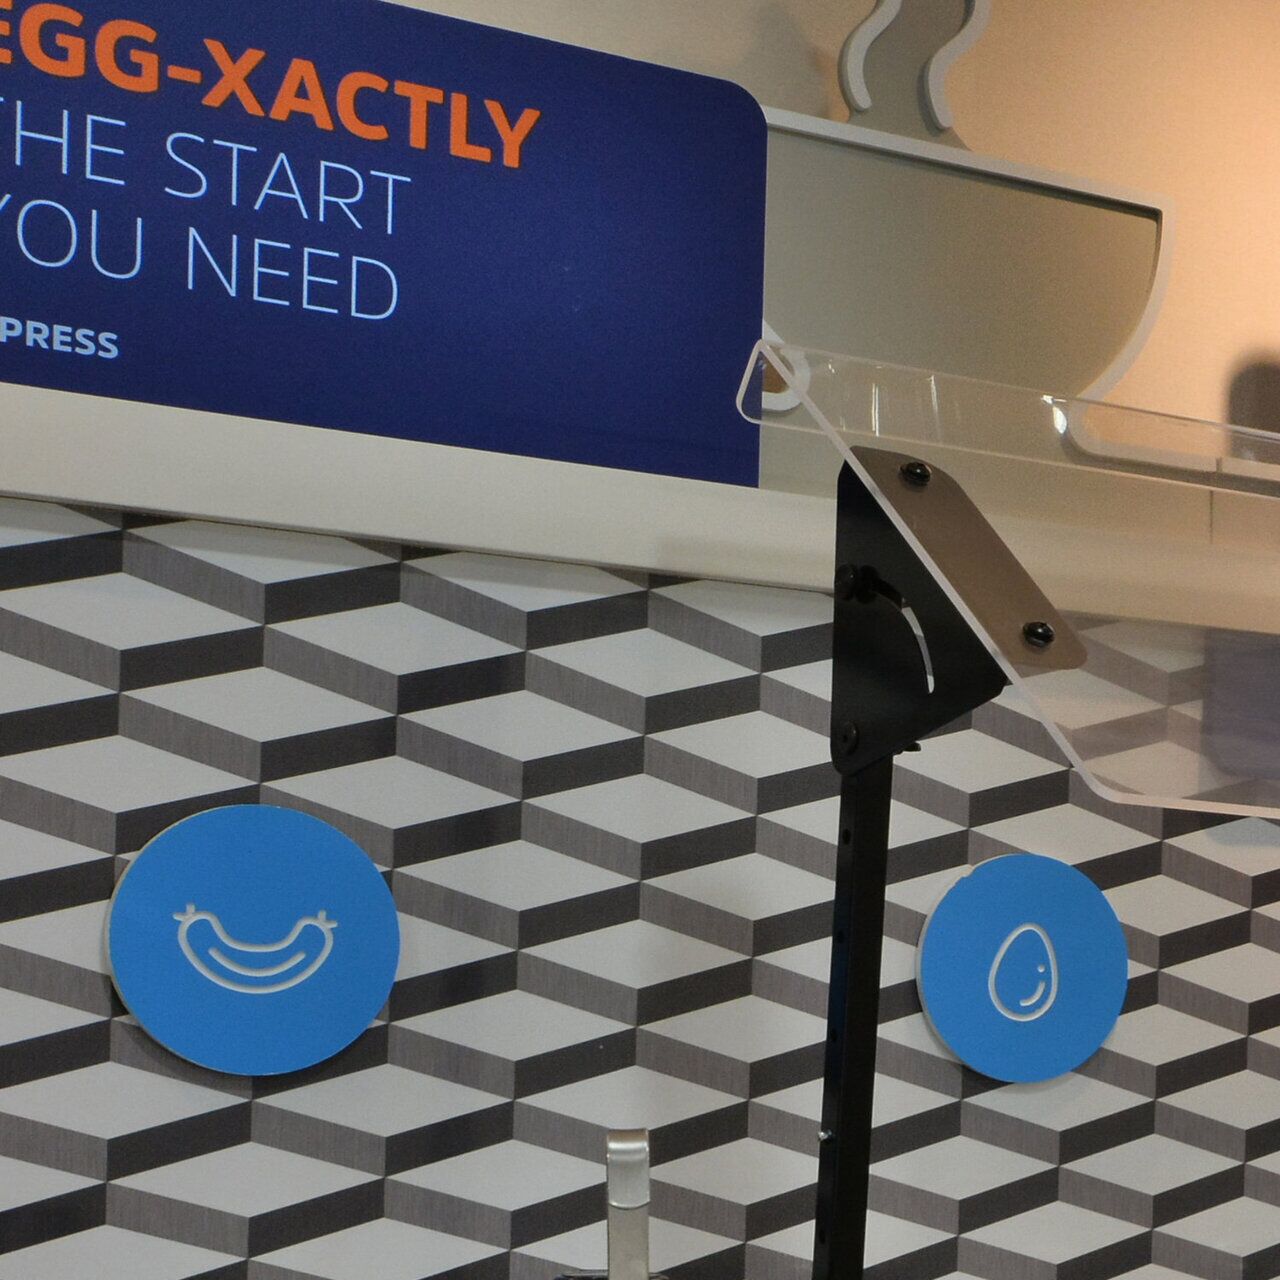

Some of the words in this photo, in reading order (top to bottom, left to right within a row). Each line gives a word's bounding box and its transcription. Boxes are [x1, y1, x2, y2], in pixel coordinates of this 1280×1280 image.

[0, 97, 127, 186] HE
[164, 131, 412, 235] START
[0, 193, 143, 281] OU
[187, 226, 399, 321] NEED
